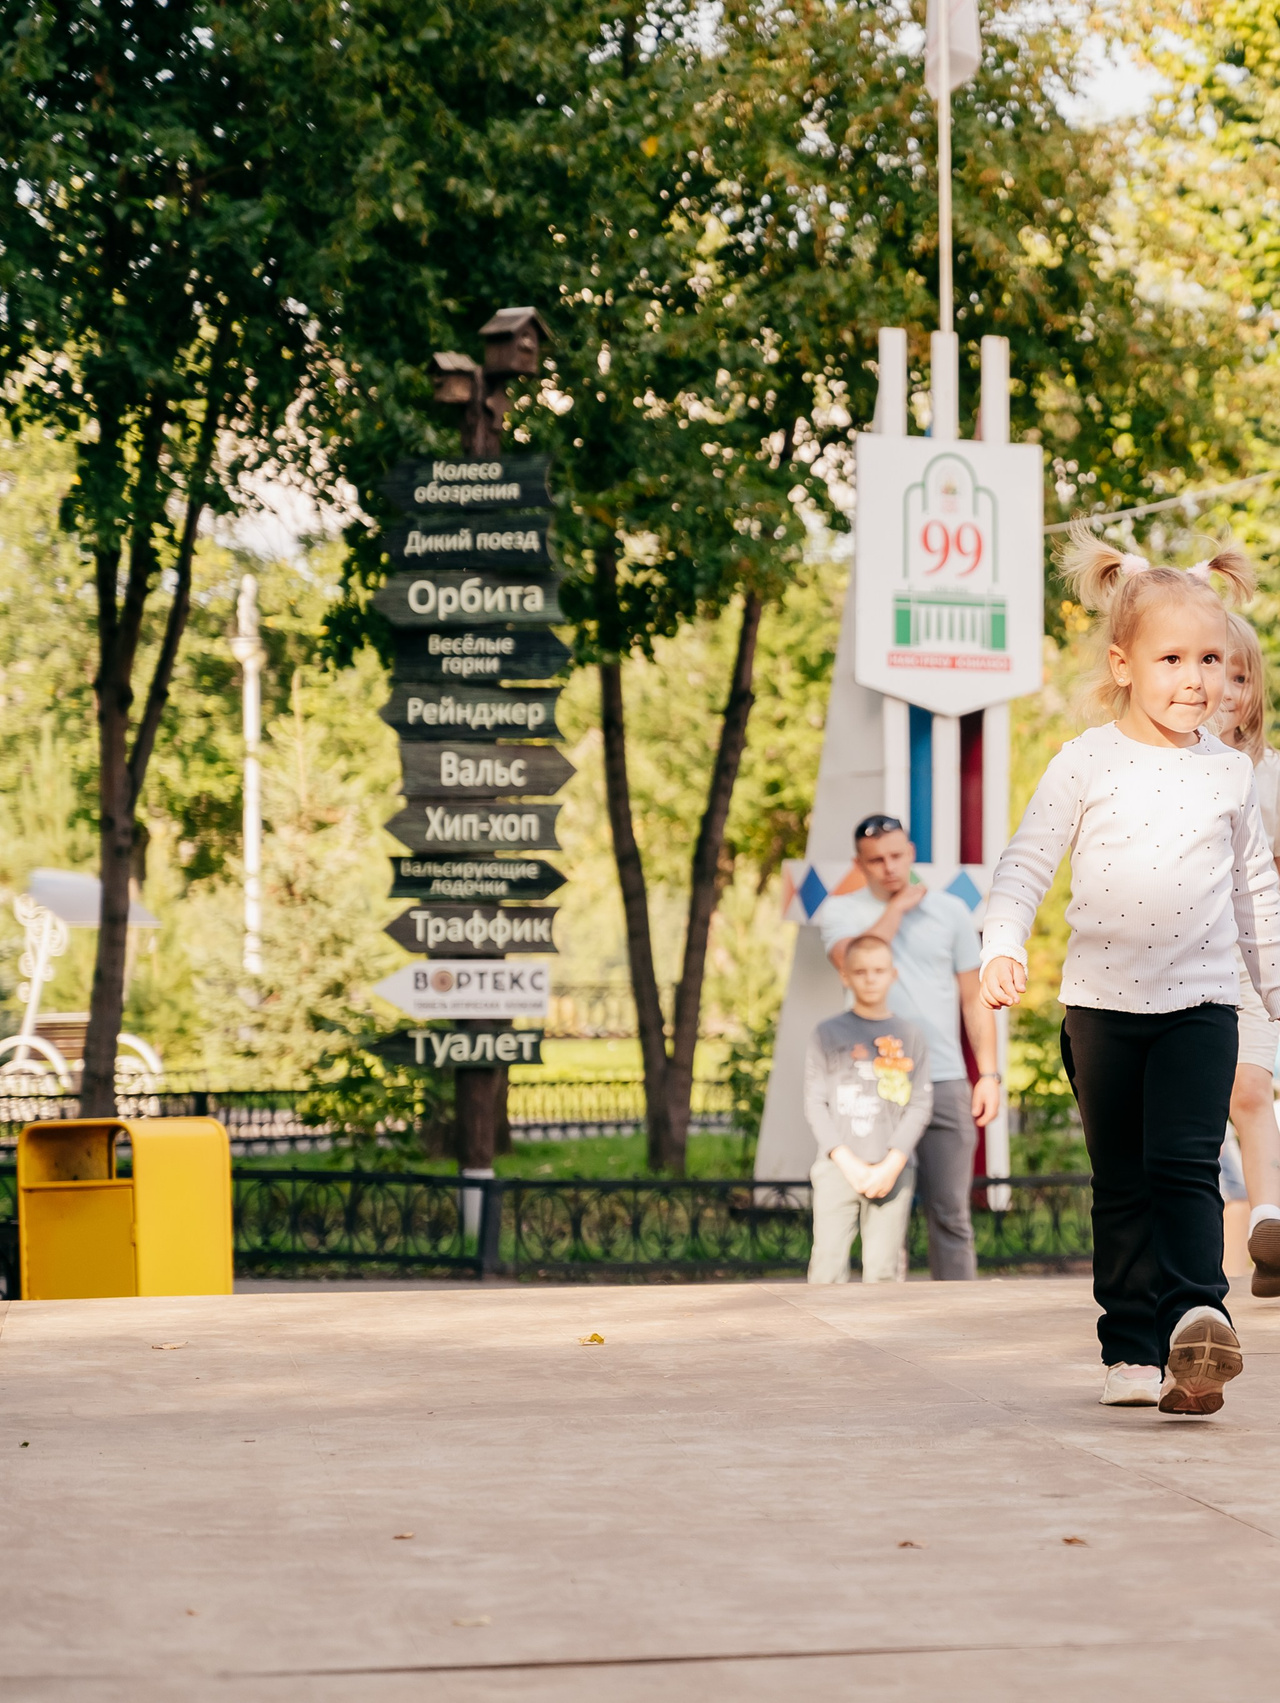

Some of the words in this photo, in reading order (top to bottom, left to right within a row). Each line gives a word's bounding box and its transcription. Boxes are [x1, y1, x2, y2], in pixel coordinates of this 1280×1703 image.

[432, 461, 503, 481] Колесо
[414, 481, 521, 506] обозрения
[404, 528, 473, 557] Дикий
[476, 530, 541, 553] поезд
[921, 519, 983, 578] 99
[407, 577, 544, 621] Орбита
[428, 633, 515, 655] Весёлые
[441, 656, 500, 678] горки
[407, 696, 546, 731] Рейнджер
[440, 751, 527, 787] Вальс
[425, 806, 540, 842] Хип-хоп
[400, 860, 541, 882] Вальсирующие
[430, 879, 509, 898] лодочки
[409, 909, 551, 949] Траффик
[413, 969, 544, 993] ВОРТЕКС
[408, 1029, 539, 1068] Туалет
